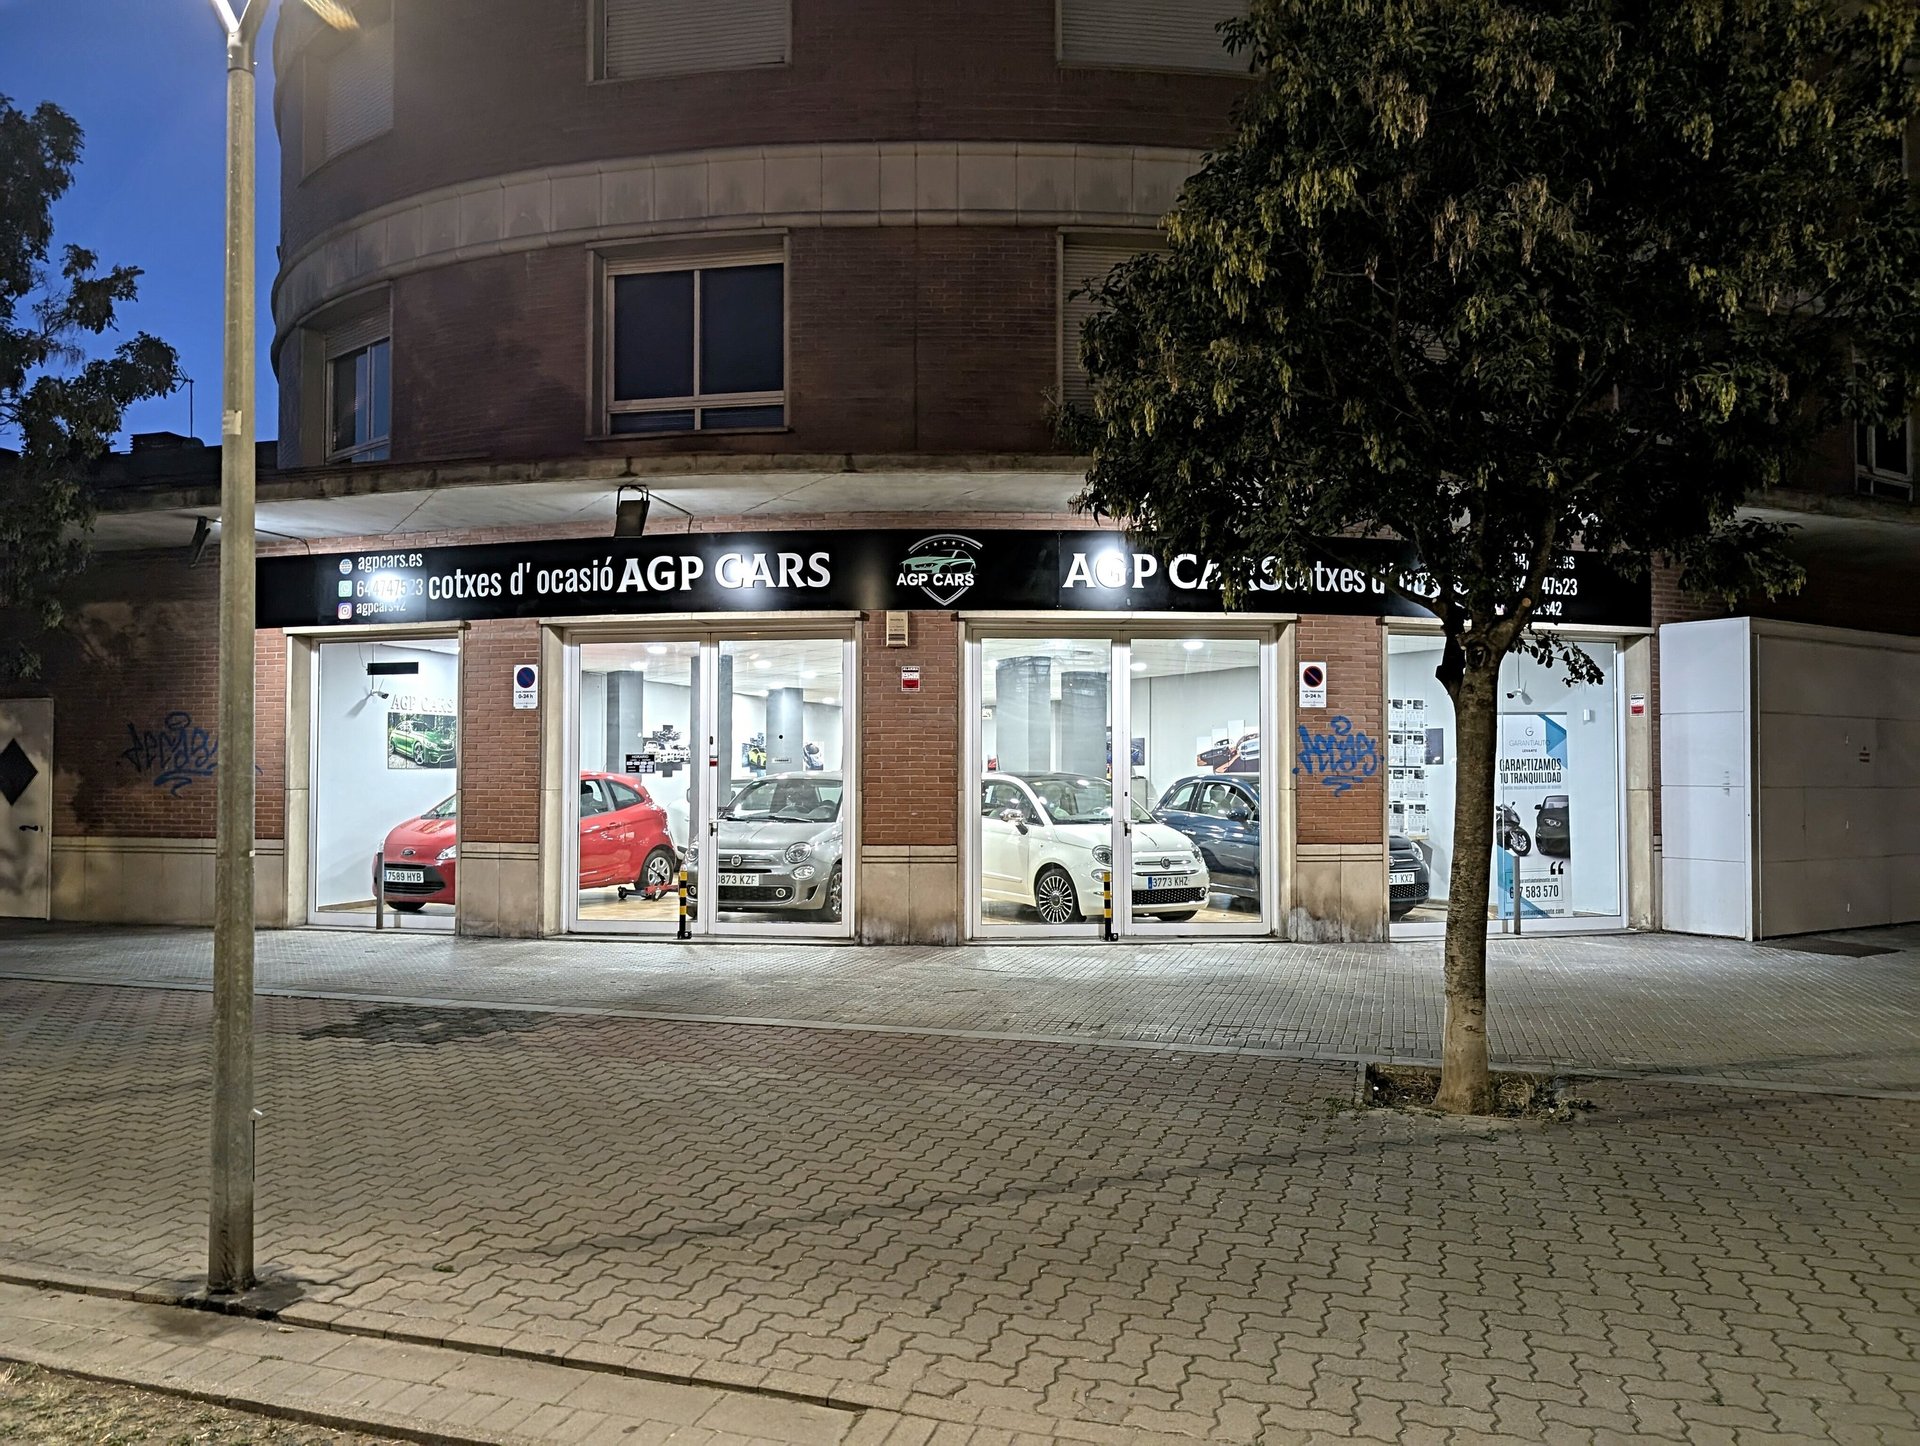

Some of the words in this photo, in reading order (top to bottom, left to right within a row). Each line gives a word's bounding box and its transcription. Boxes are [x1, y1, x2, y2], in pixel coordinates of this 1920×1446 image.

[357, 553, 423, 573] agpcars.es
[616, 555, 704, 593] AGP
[714, 551, 831, 589] CARS
[1061, 552, 1158, 589] AGP
[428, 568, 502, 600] cotxes
[537, 556, 614, 594] ocasió
[896, 573, 928, 586] AGP
[932, 573, 975, 587] CARS
[1499, 758, 1562, 772] GARANTIZAMOS
[1510, 772, 1562, 784] TRANQUILIDAD
[387, 871, 405, 881] 7589
[406, 873, 422, 882] HYB
[739, 875, 757, 885] KZF
[1152, 877, 1173, 888] 3773
[1174, 876, 1188, 886] KHZ
[1509, 887, 1523, 899] 67
[1525, 886, 1541, 899] 583
[1543, 885, 1559, 897] 570
